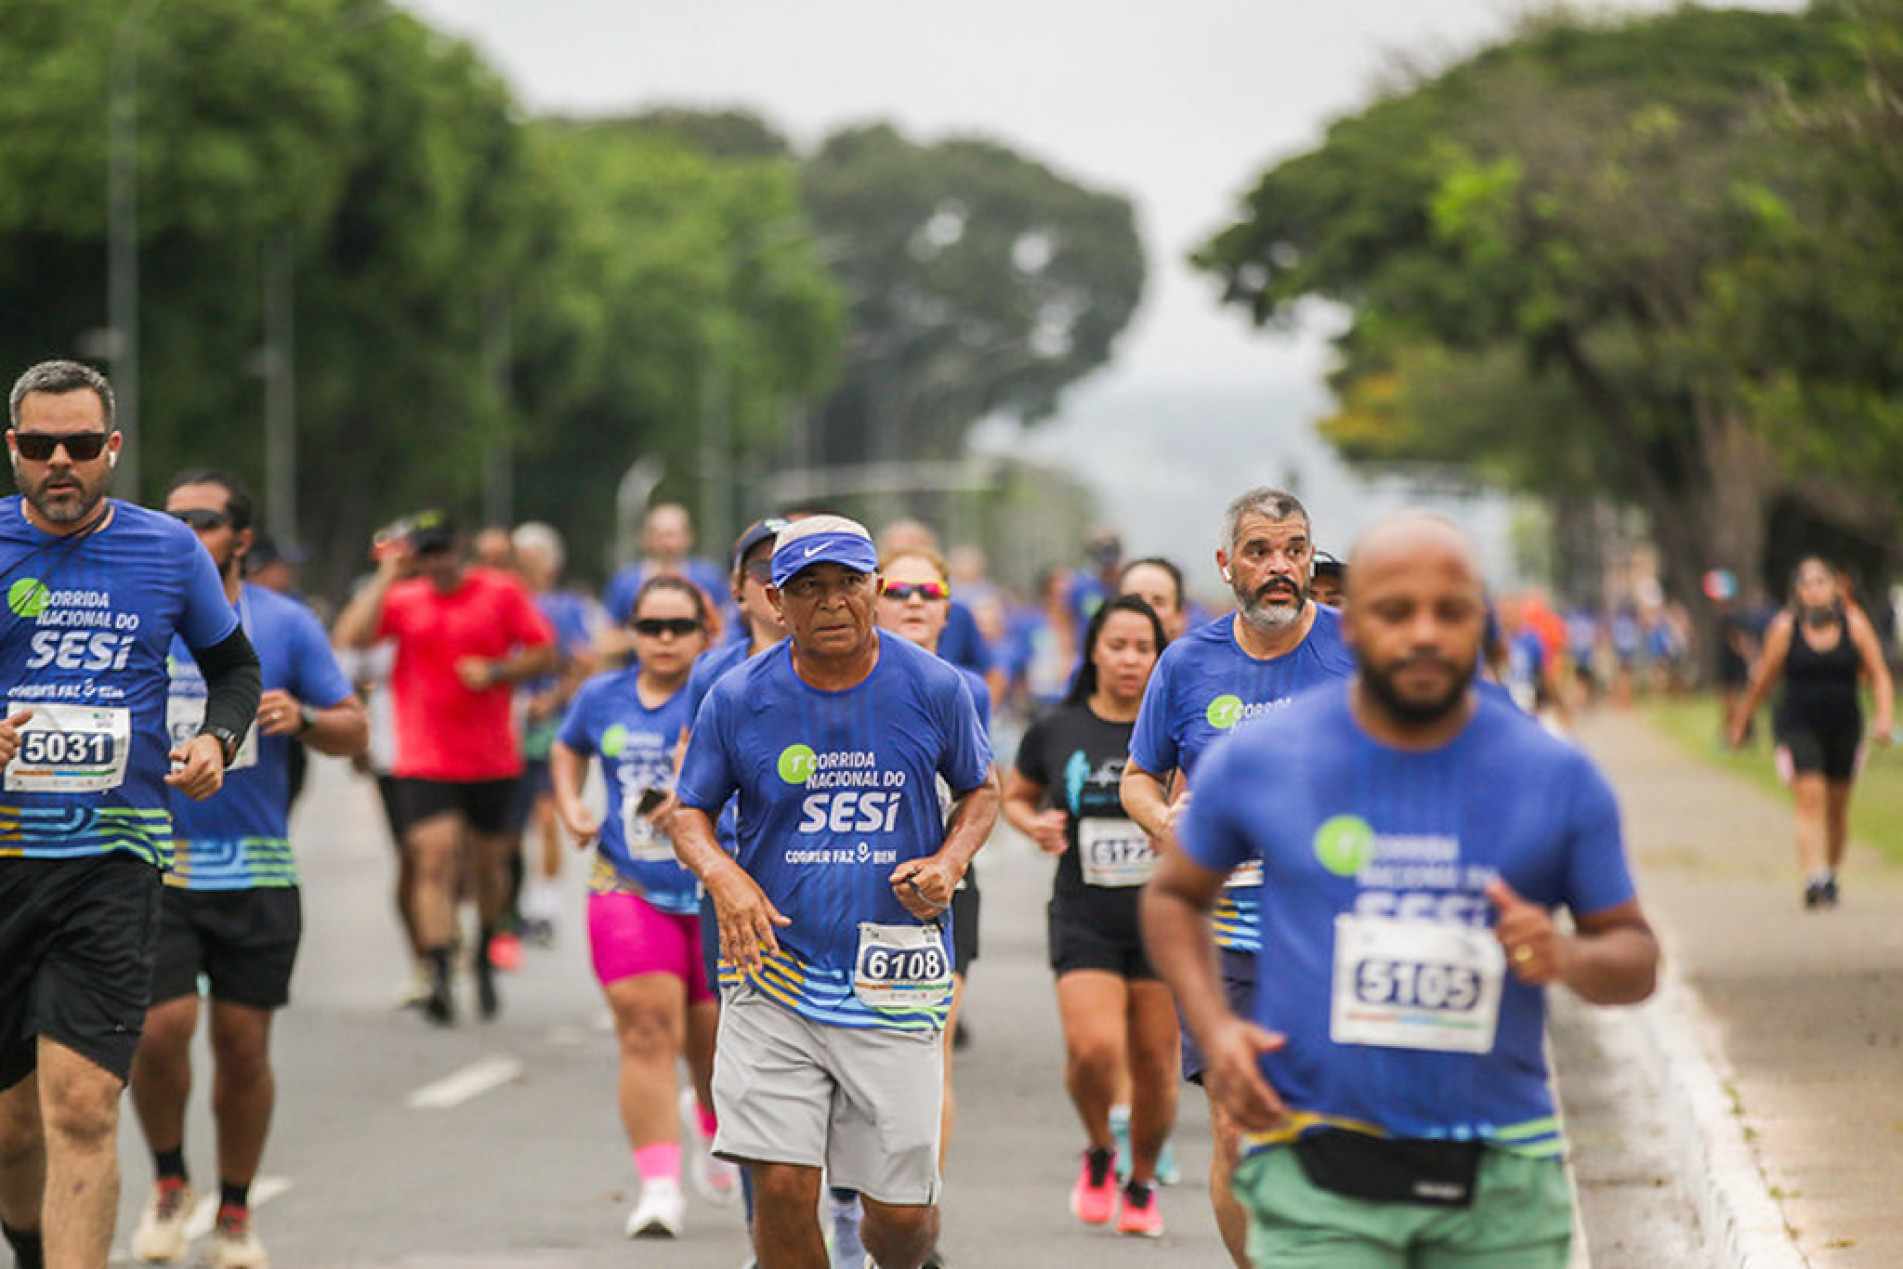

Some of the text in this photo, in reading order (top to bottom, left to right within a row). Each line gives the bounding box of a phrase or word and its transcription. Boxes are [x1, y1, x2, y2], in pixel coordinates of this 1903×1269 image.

[36, 608, 140, 630] NACIONAL DO
[25, 733, 105, 762] 5031
[806, 751, 876, 771] CORRIDA
[805, 769, 907, 790] NACIONAL DO
[869, 950, 940, 979] 6108
[1362, 960, 1475, 1011] 5105
